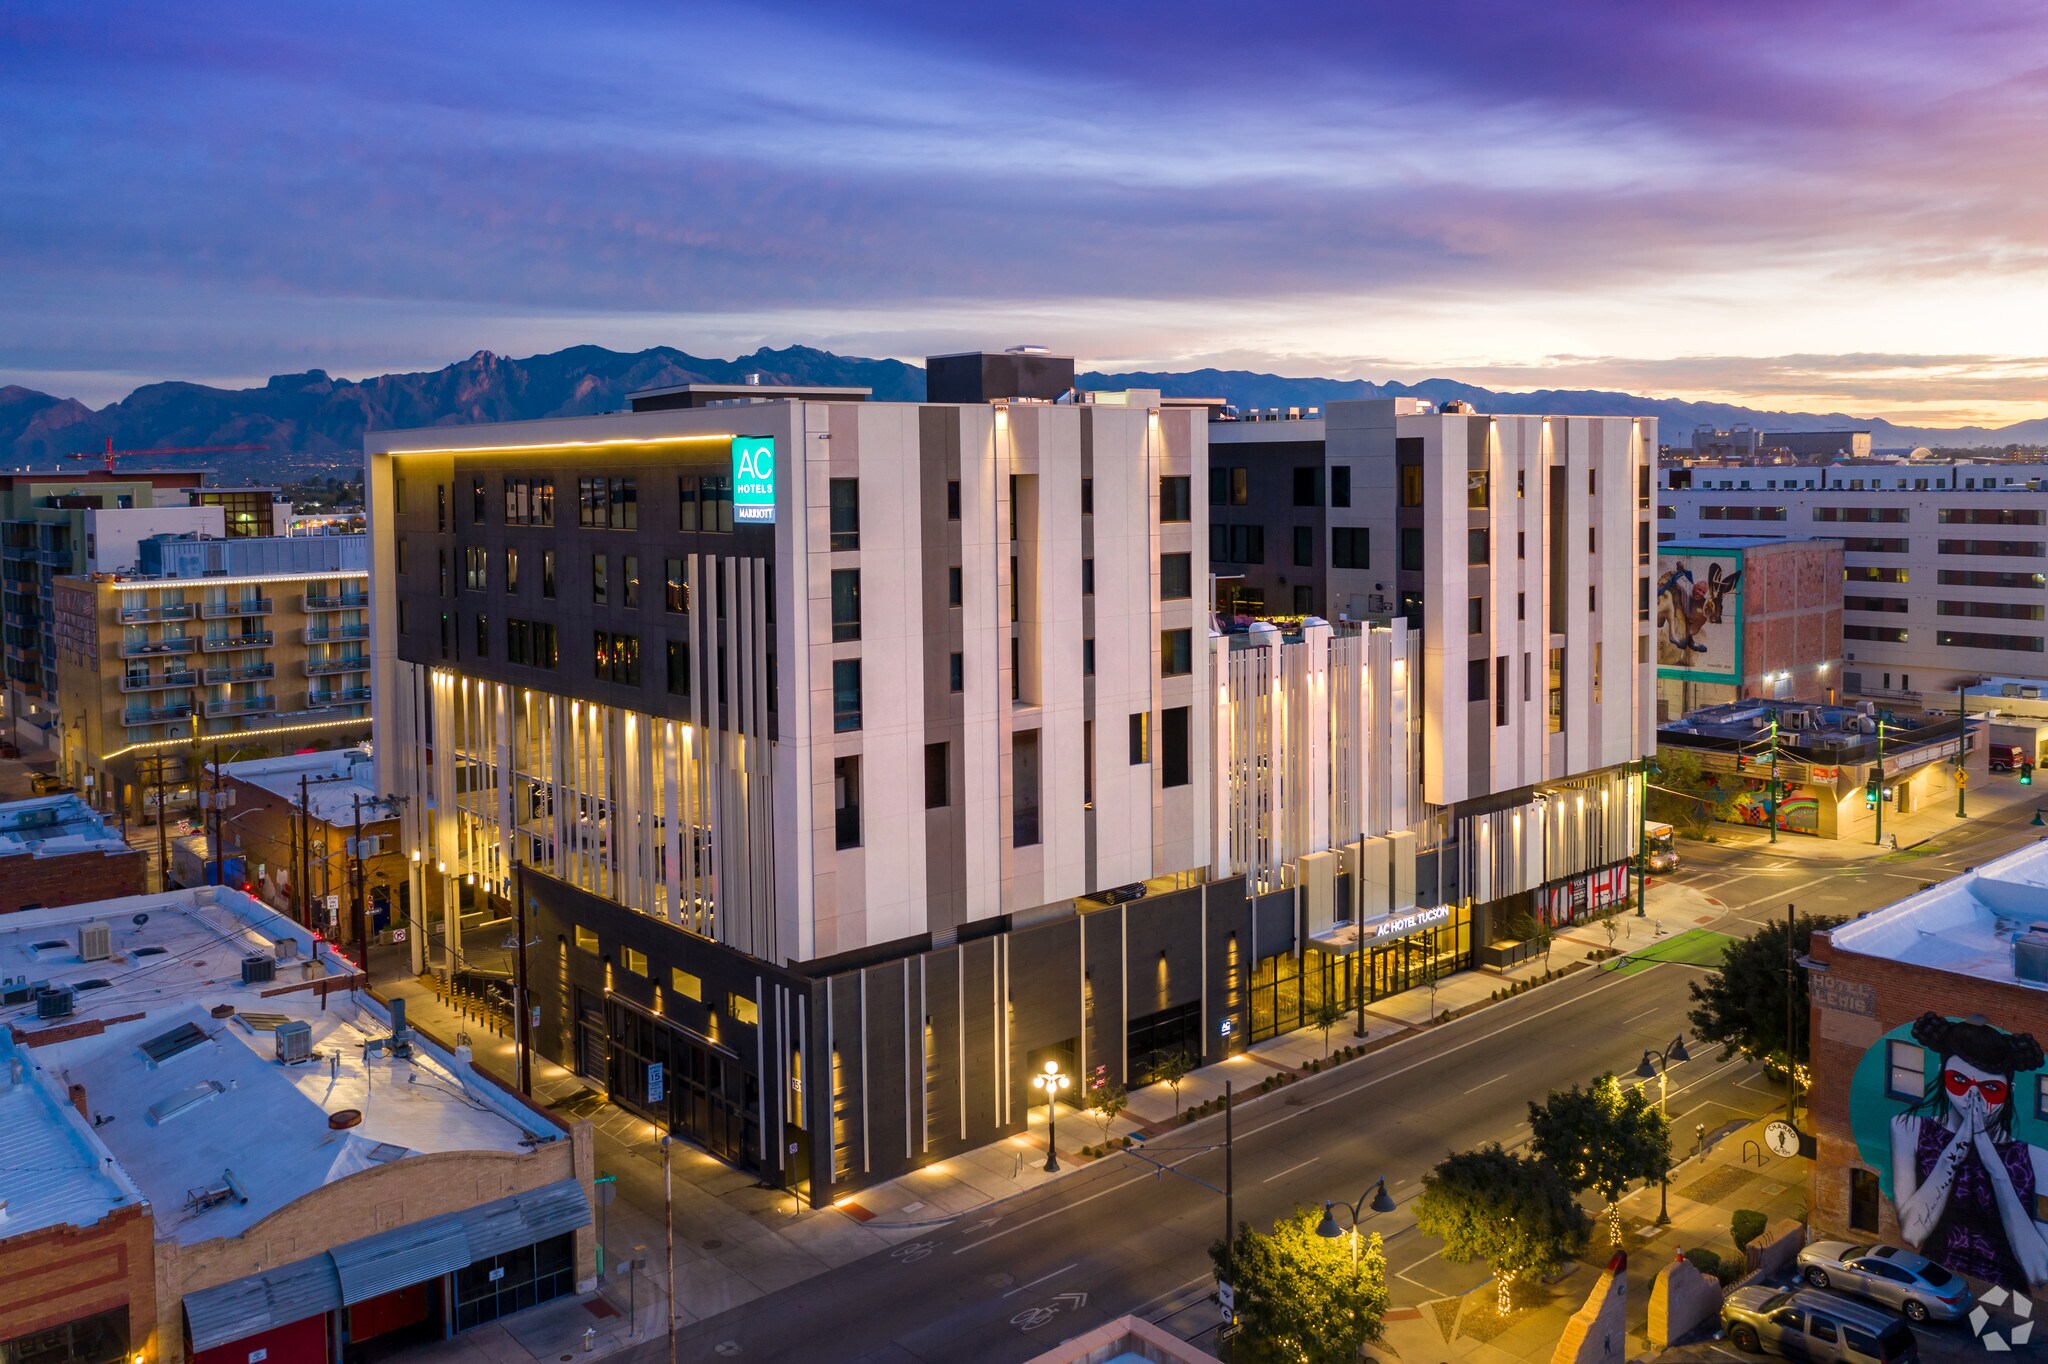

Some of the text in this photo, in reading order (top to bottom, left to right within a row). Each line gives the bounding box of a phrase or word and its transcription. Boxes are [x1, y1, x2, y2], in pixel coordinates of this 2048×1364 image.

[737, 447, 772, 480] AC
[737, 484, 773, 494] HOTELS
[739, 508, 773, 519] MARRIOTT
[1573, 878, 1586, 887] VOLK
[1377, 905, 1449, 936] AC HOTEL TUCSON
[651, 1072, 661, 1081] 15
[1768, 1124, 1796, 1138] CHARRO
